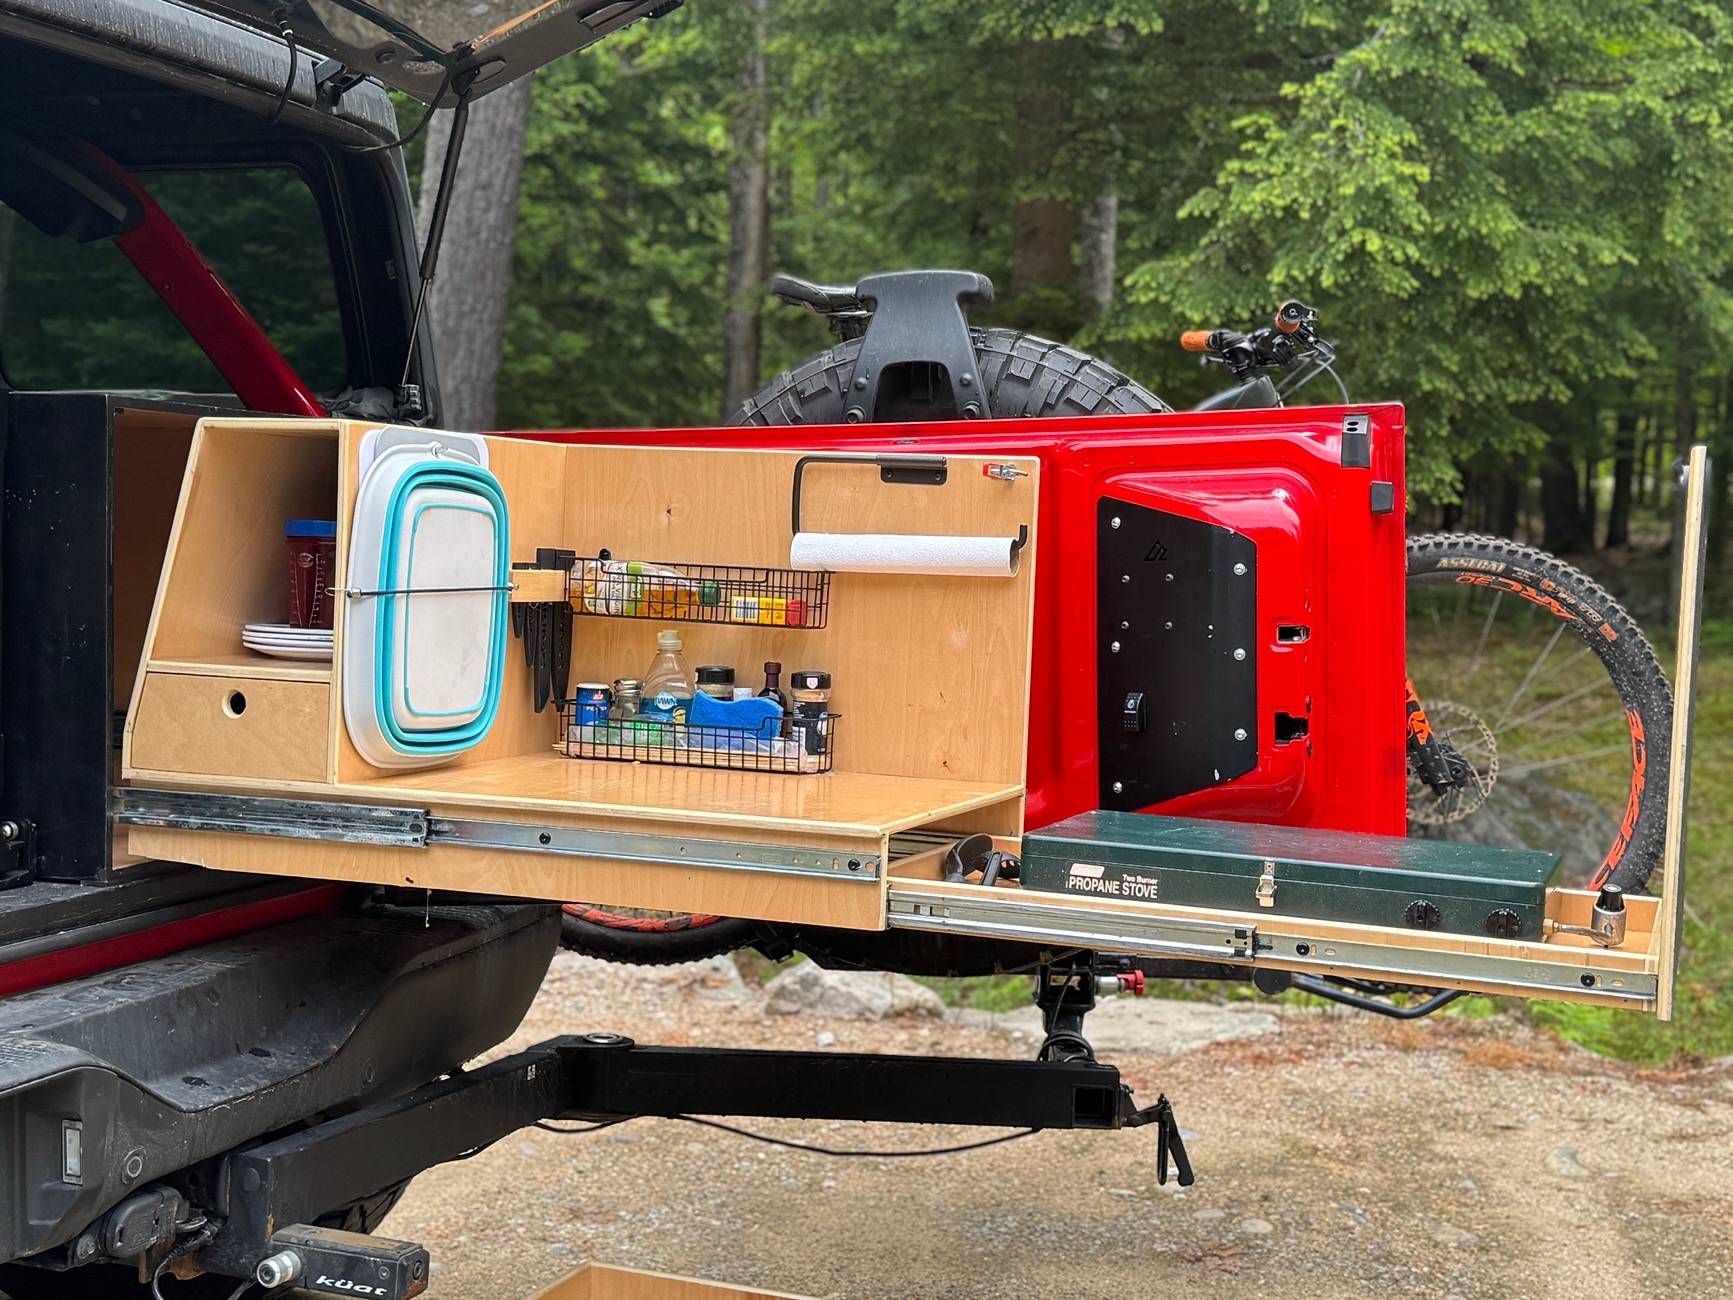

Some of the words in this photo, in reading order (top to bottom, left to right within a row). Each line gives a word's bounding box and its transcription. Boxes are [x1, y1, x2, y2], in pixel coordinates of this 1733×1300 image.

[1069, 876, 1120, 895] PROPANE
[1122, 883, 1158, 899] STOVE
[1122, 874, 1136, 882] Two
[1136, 875, 1159, 884] Burner
[315, 1275, 388, 1296] küat
